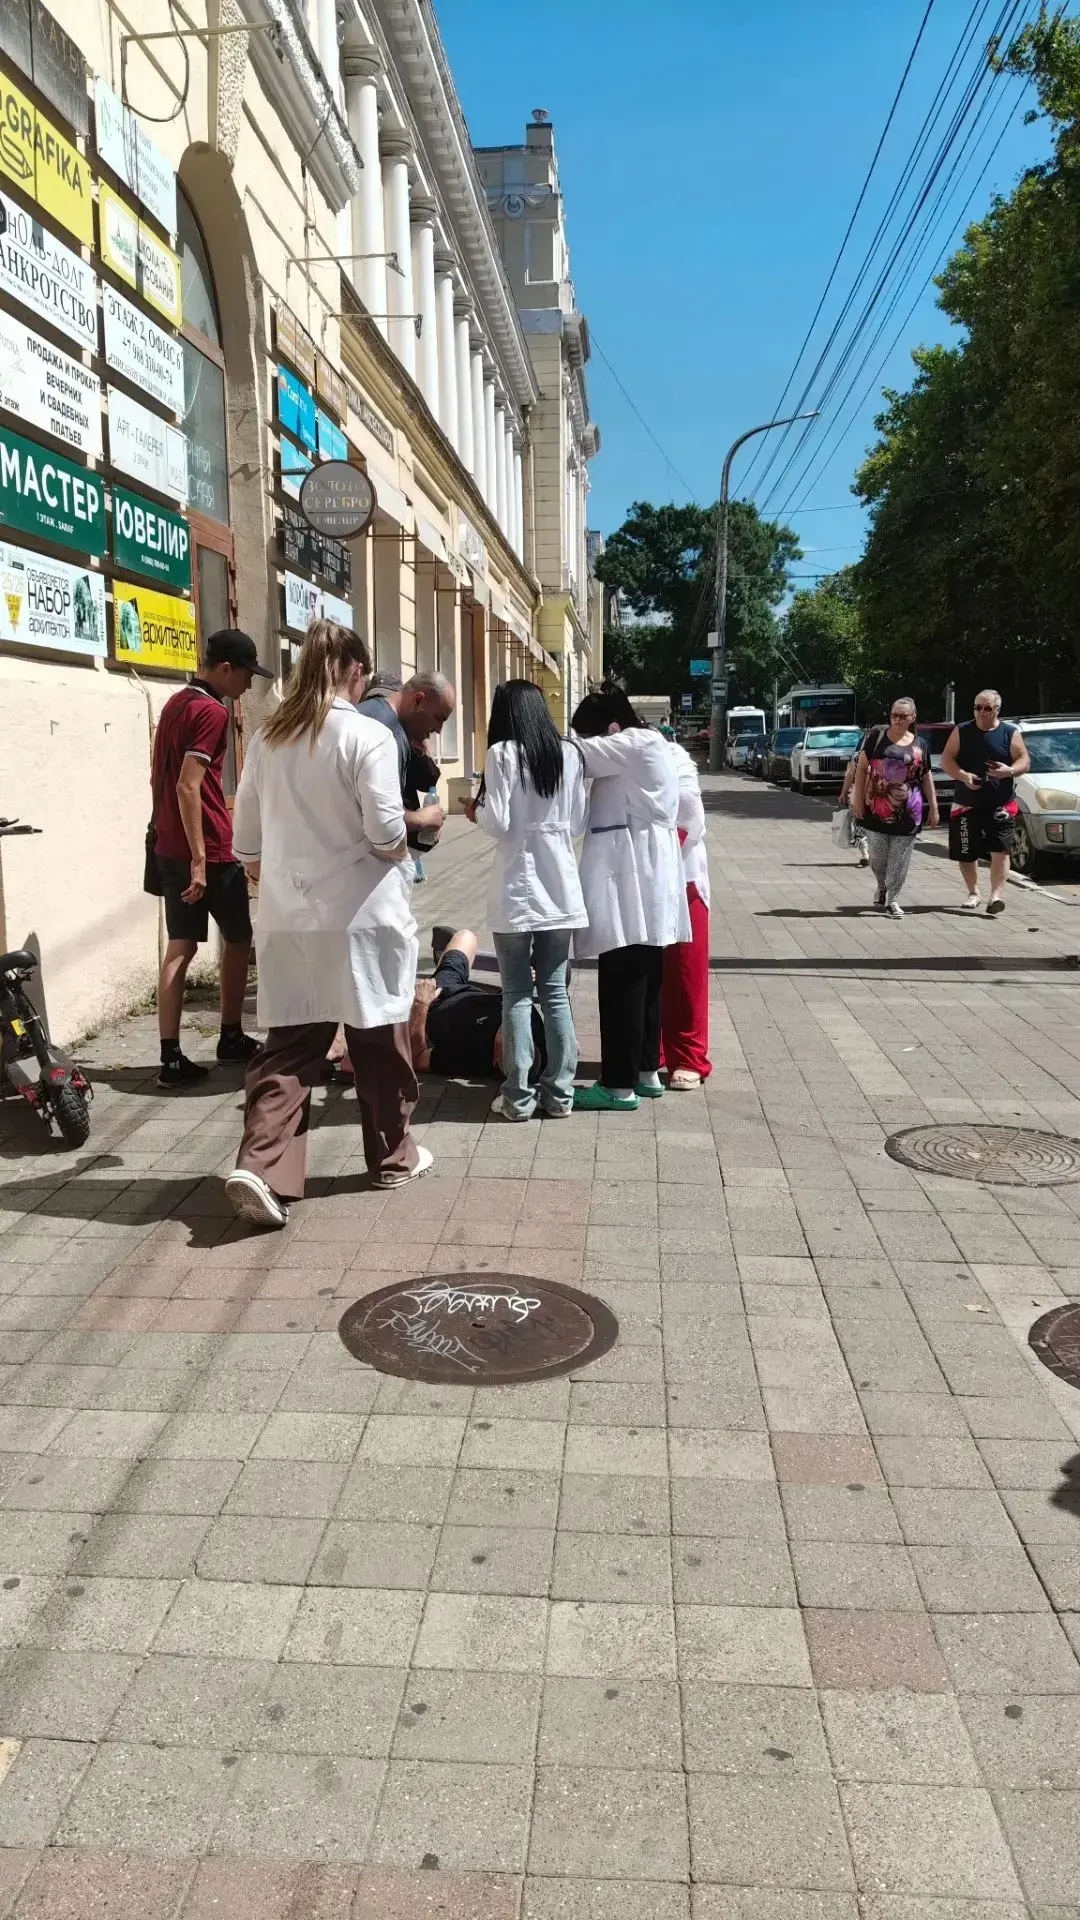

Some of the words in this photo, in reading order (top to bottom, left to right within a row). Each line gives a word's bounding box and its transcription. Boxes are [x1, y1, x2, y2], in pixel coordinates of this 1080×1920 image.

[108, 294, 138, 338] ЭТАЖ
[149, 329, 175, 365] ОФИС
[27, 336, 63, 372] ПРОДАЖА
[65, 360, 70, 376] И
[71, 366, 98, 392] ПРОКАТ
[46, 371, 82, 404] ВЕЧЕРНИХ
[40, 389, 45, 405] И
[47, 394, 89, 429] СВАДЕБНЫХ
[50, 417, 82, 446] ПЛАТЬЕВ
[0, 442, 99, 523] МАСТЕР
[305, 496, 369, 509] СЕРЕБРО
[115, 497, 188, 561] ЮВЕЛИР
[28, 581, 71, 616] НАБОР
[29, 617, 71, 639] архитектон
[143, 621, 196, 652] архитектон
